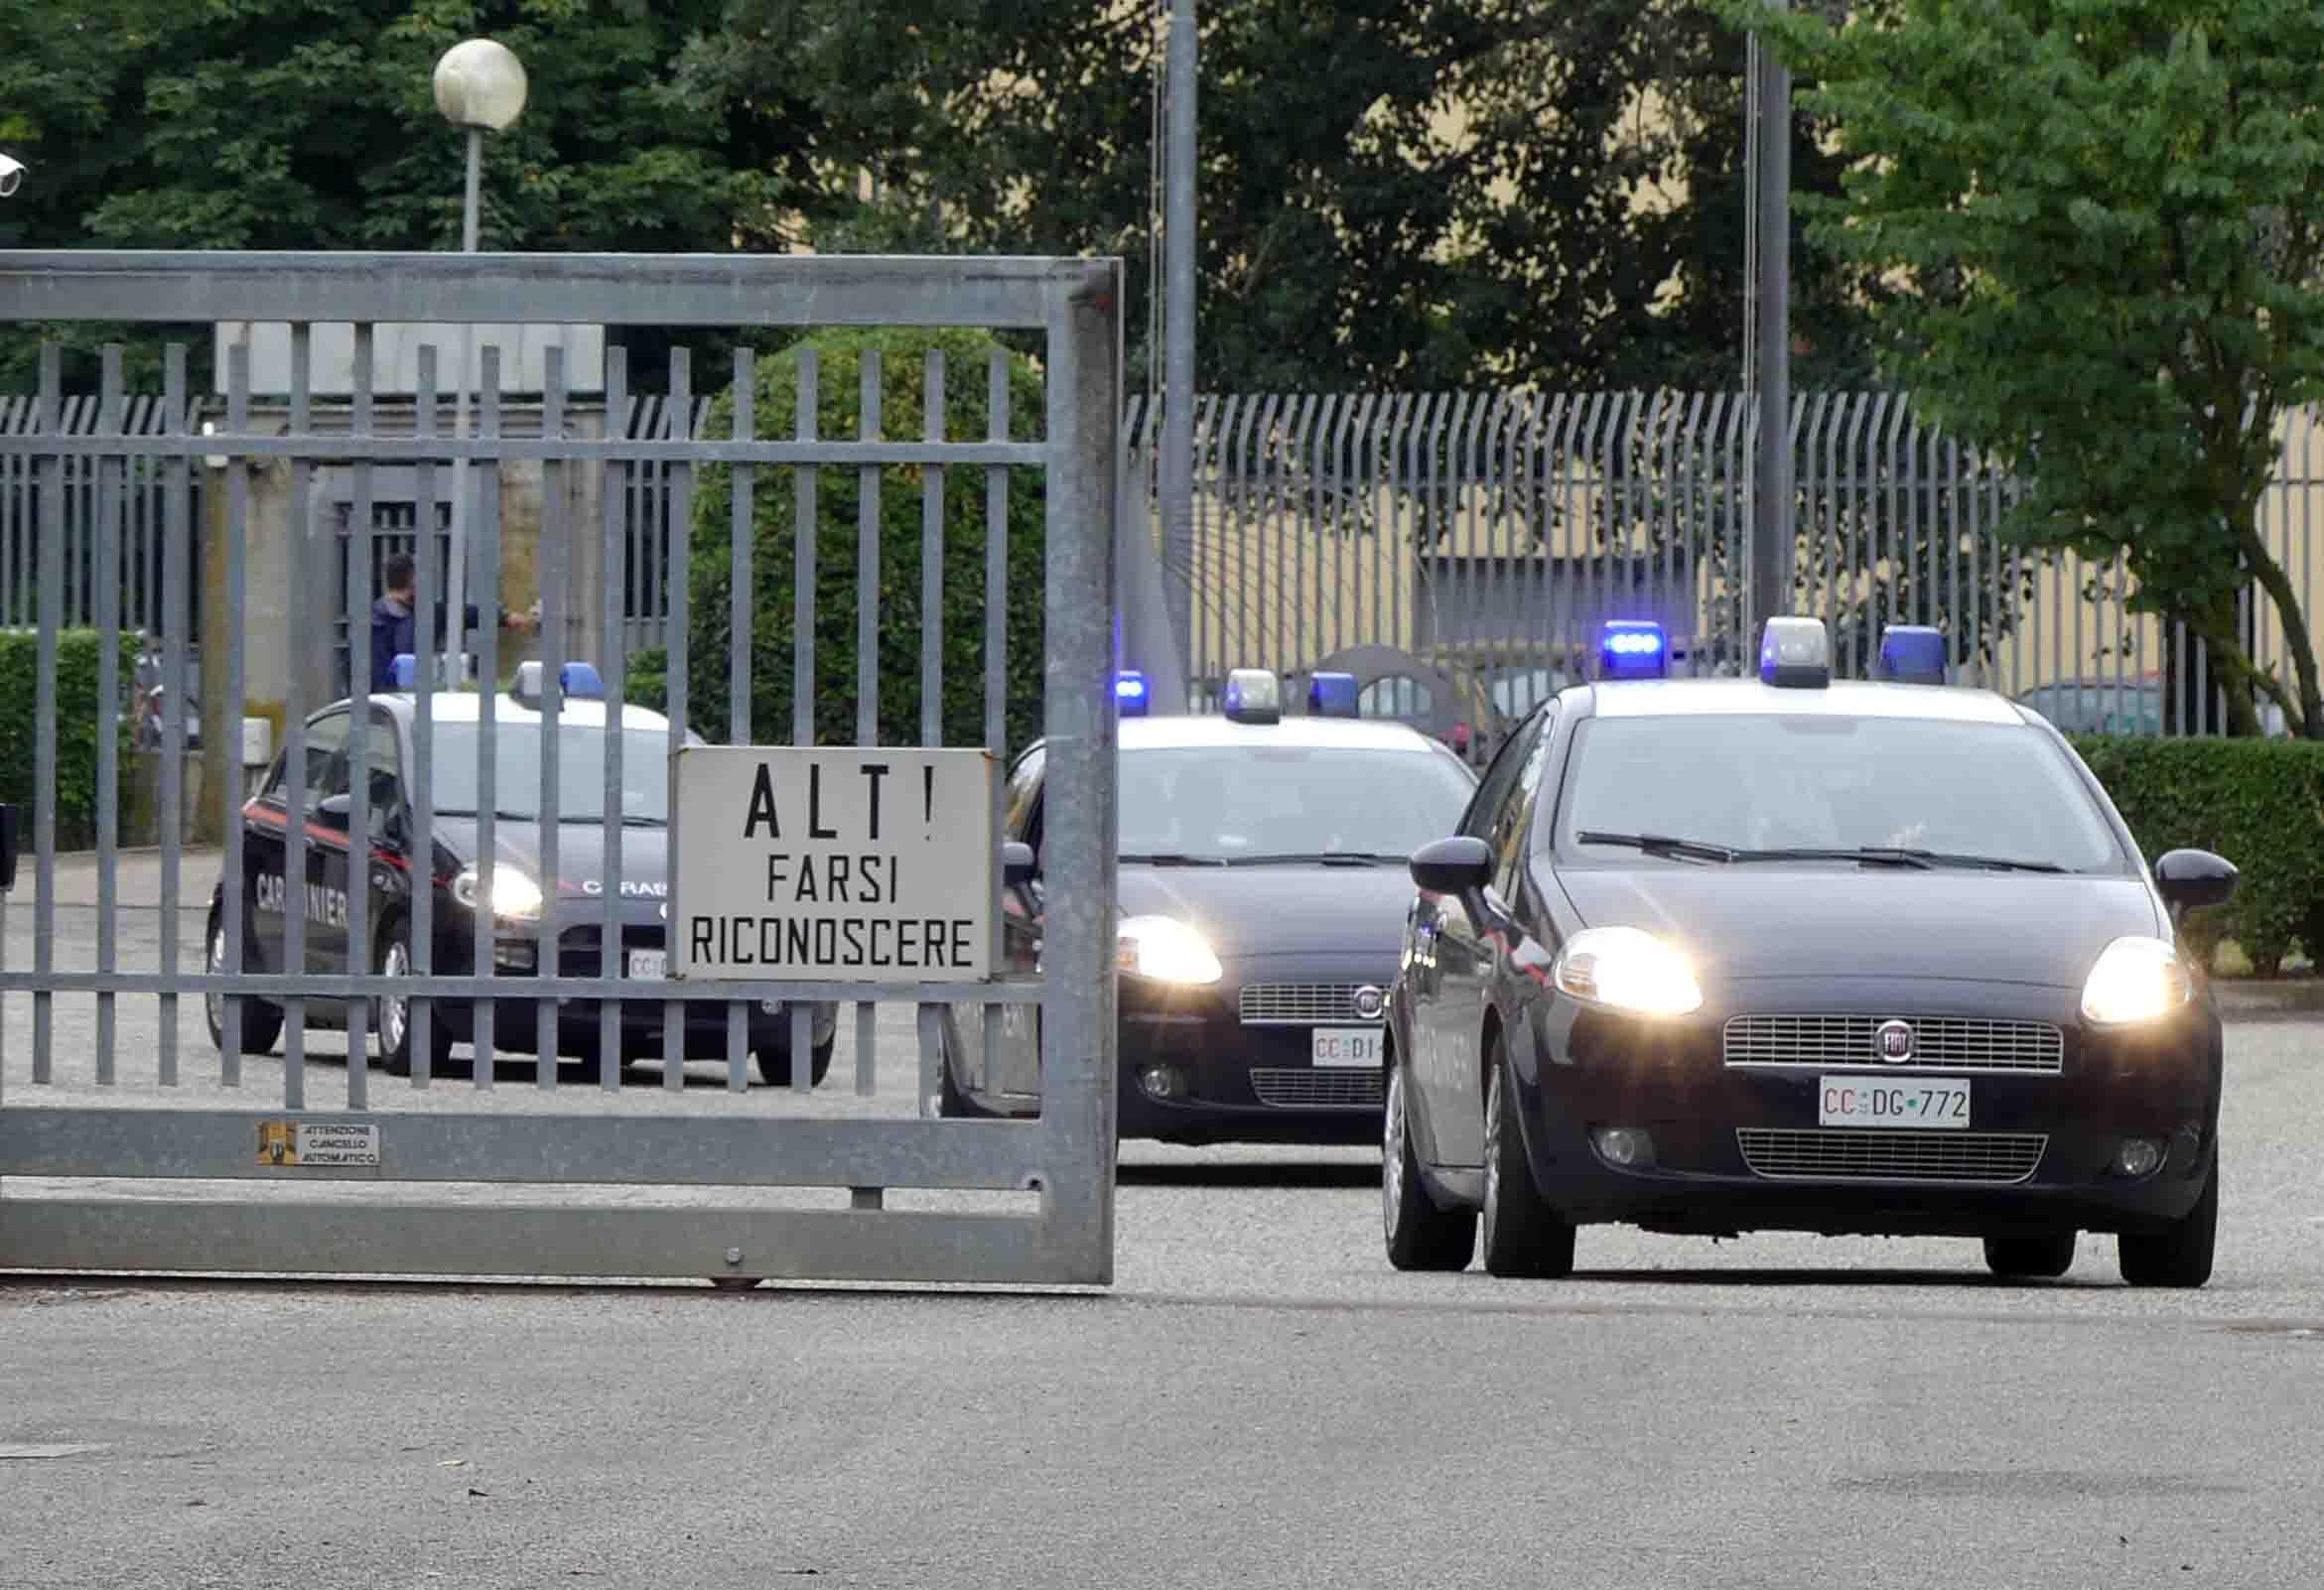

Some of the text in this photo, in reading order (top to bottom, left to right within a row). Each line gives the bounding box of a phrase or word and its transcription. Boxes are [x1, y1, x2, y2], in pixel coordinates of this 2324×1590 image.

[767, 855, 896, 903] FARSI
[692, 916, 973, 967] RICONOSCERE
[1884, 1032, 1907, 1053] FIAT
[1919, 1090, 1968, 1118] 772
